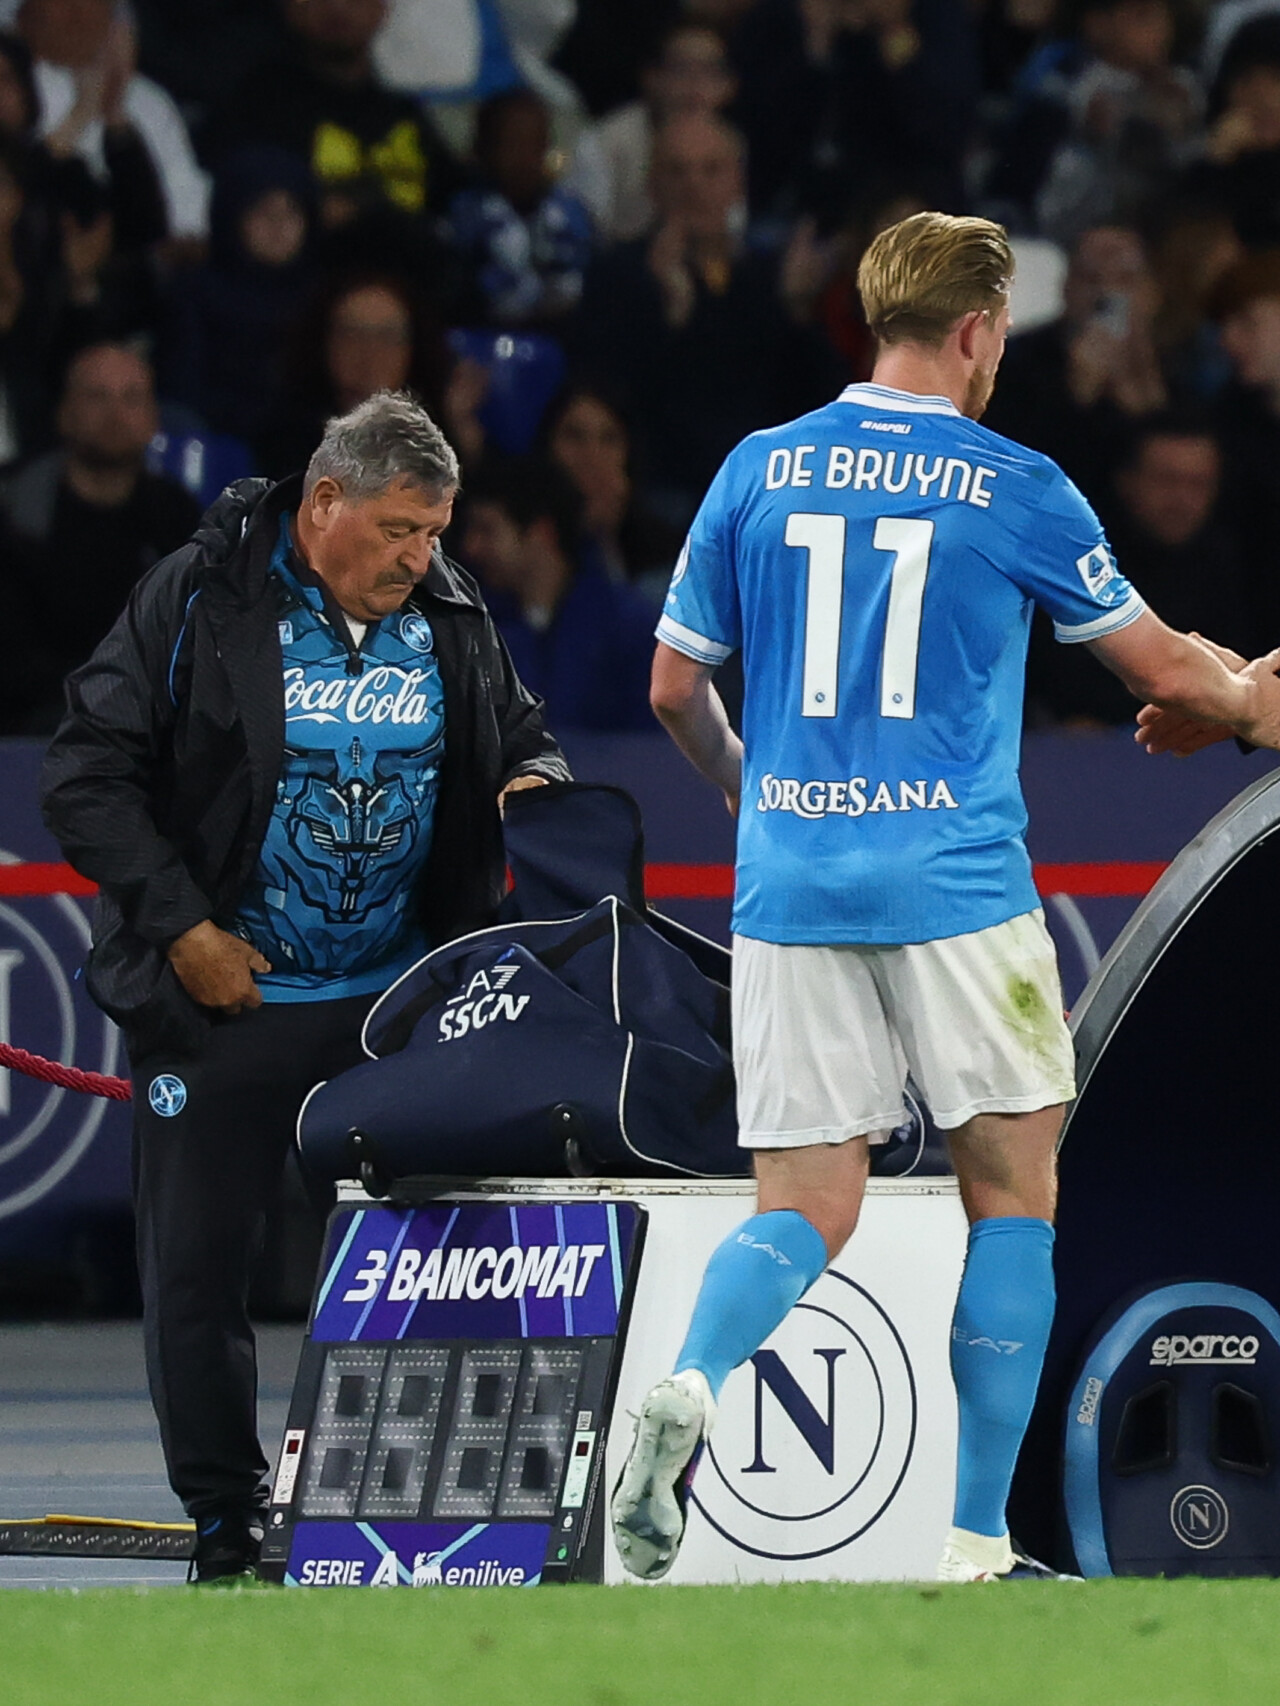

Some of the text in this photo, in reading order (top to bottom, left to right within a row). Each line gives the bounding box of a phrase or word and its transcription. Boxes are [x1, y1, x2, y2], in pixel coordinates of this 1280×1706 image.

[765, 445, 998, 508] DE BRUYNE
[784, 512, 935, 720] 11
[446, 965, 521, 1005] A7
[438, 993, 530, 1042] SSCN
[387, 1245, 606, 1301] BANCOMAT
[1150, 1335, 1260, 1366] sparco
[740, 1348, 847, 1476] N
[1187, 1503, 1210, 1531] N
[300, 1550, 525, 1588] SERIE A enilive
